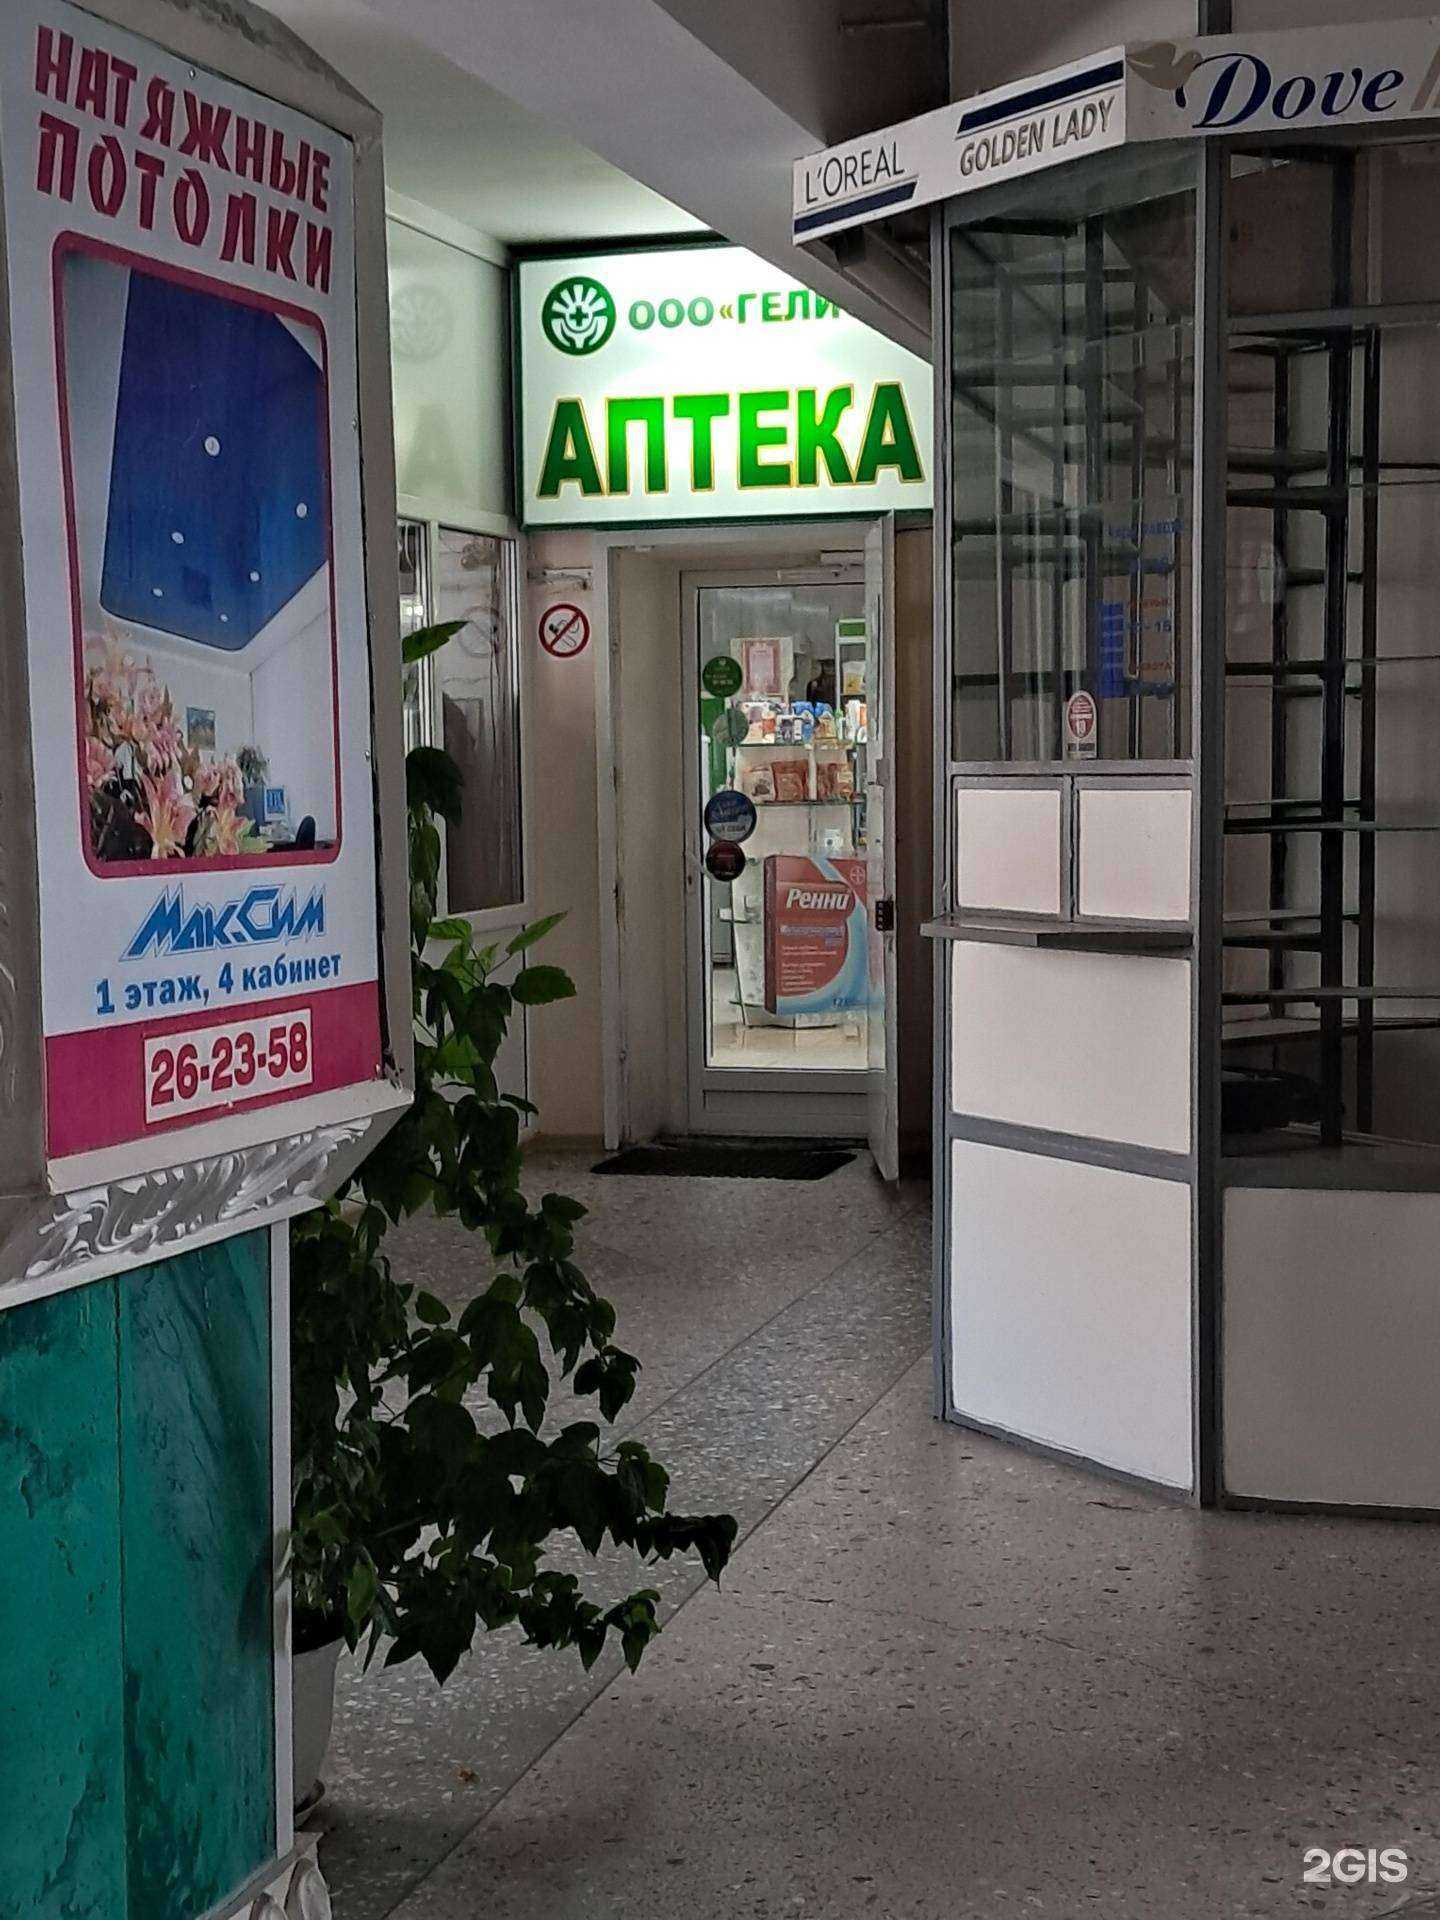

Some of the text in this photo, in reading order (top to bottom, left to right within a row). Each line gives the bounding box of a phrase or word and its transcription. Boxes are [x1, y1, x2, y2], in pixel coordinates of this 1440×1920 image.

[35, 25, 331, 213] НАТЯЖНЫЕ
[1175, 52, 1405, 129] Dove
[805, 141, 904, 205] L'OREAL
[960, 95, 1115, 177] GOLDEN LADY
[37, 110, 332, 294] ПОТОЛКИ
[628, 298, 714, 330] ООО
[536, 381, 926, 499] АПТЕКА
[786, 888, 849, 910] Ренни
[96, 953, 342, 1015] 1 этаж, 4 кабинет
[150, 1021, 309, 1107] 26-23-58
